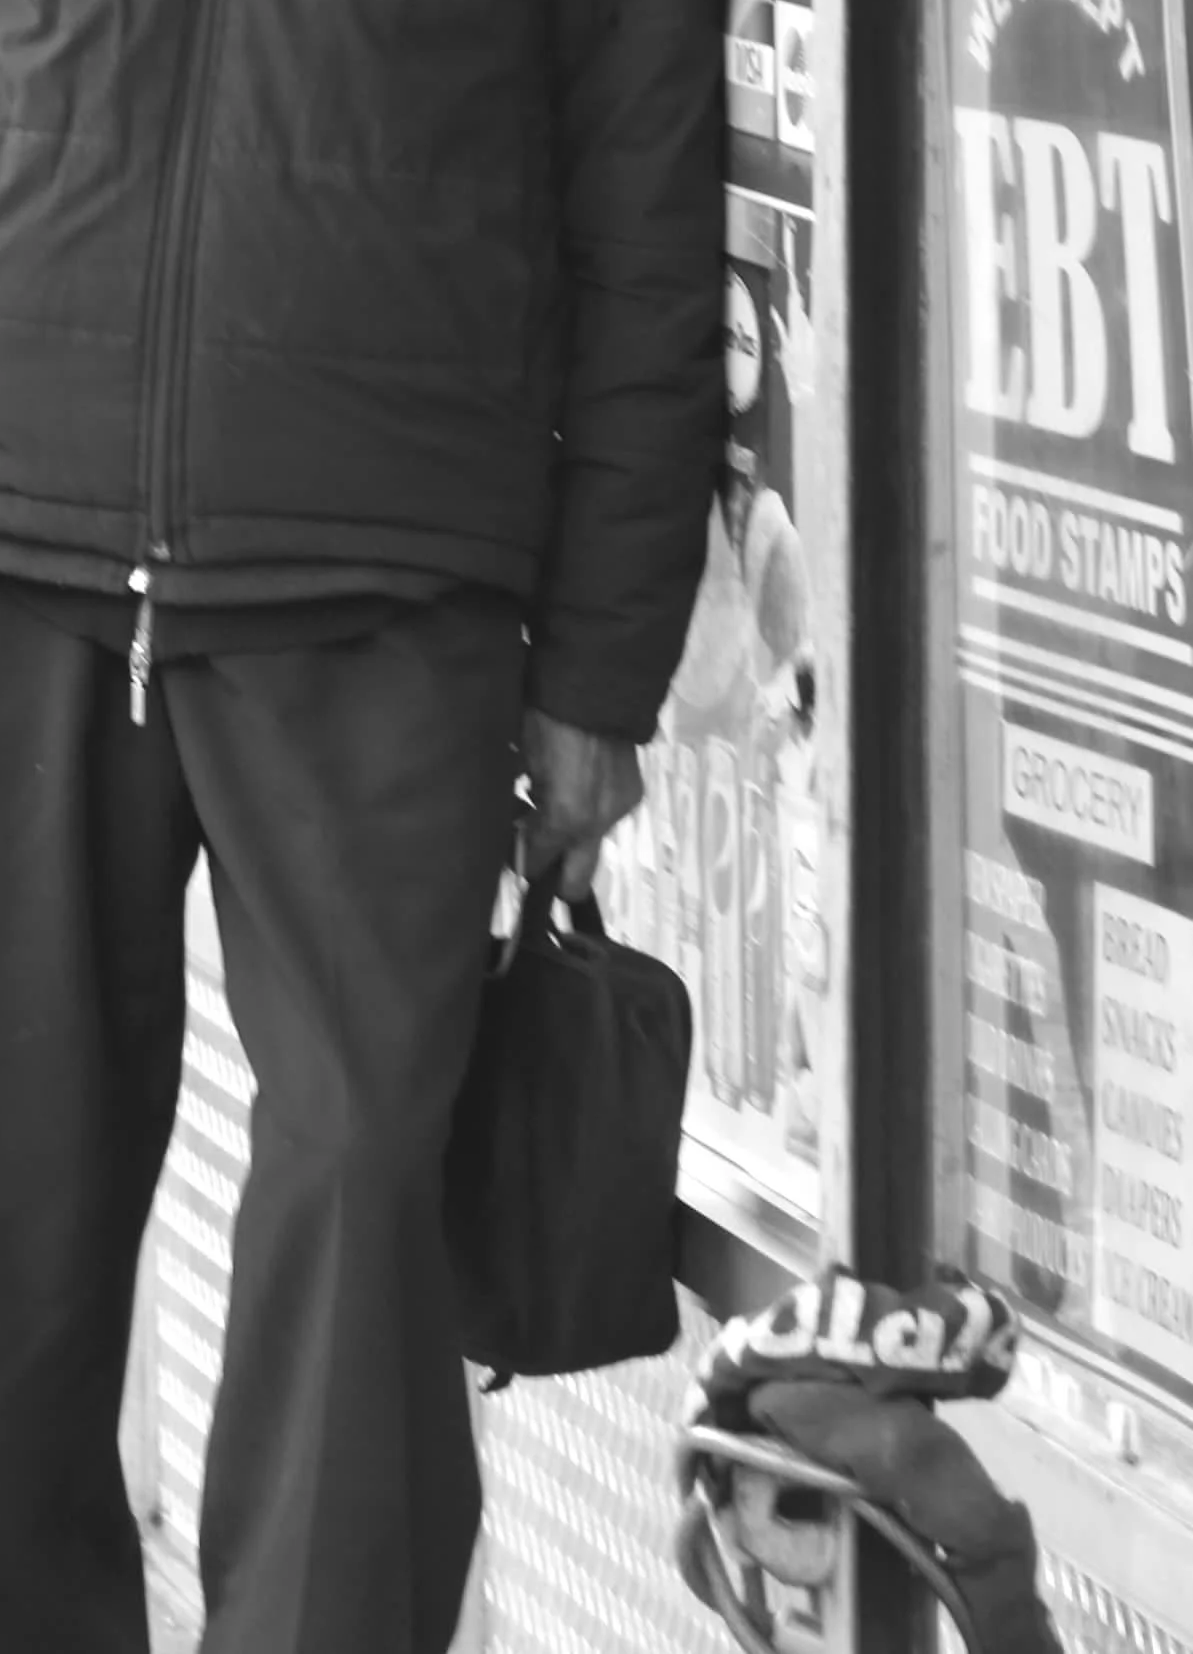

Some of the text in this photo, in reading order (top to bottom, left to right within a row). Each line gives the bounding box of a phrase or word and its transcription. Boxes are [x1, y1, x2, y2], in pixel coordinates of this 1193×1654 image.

[953, 105, 1176, 466] EBT
[971, 482, 1186, 627] FOOD STAMPS
[1012, 745, 1145, 841] GROCERY
